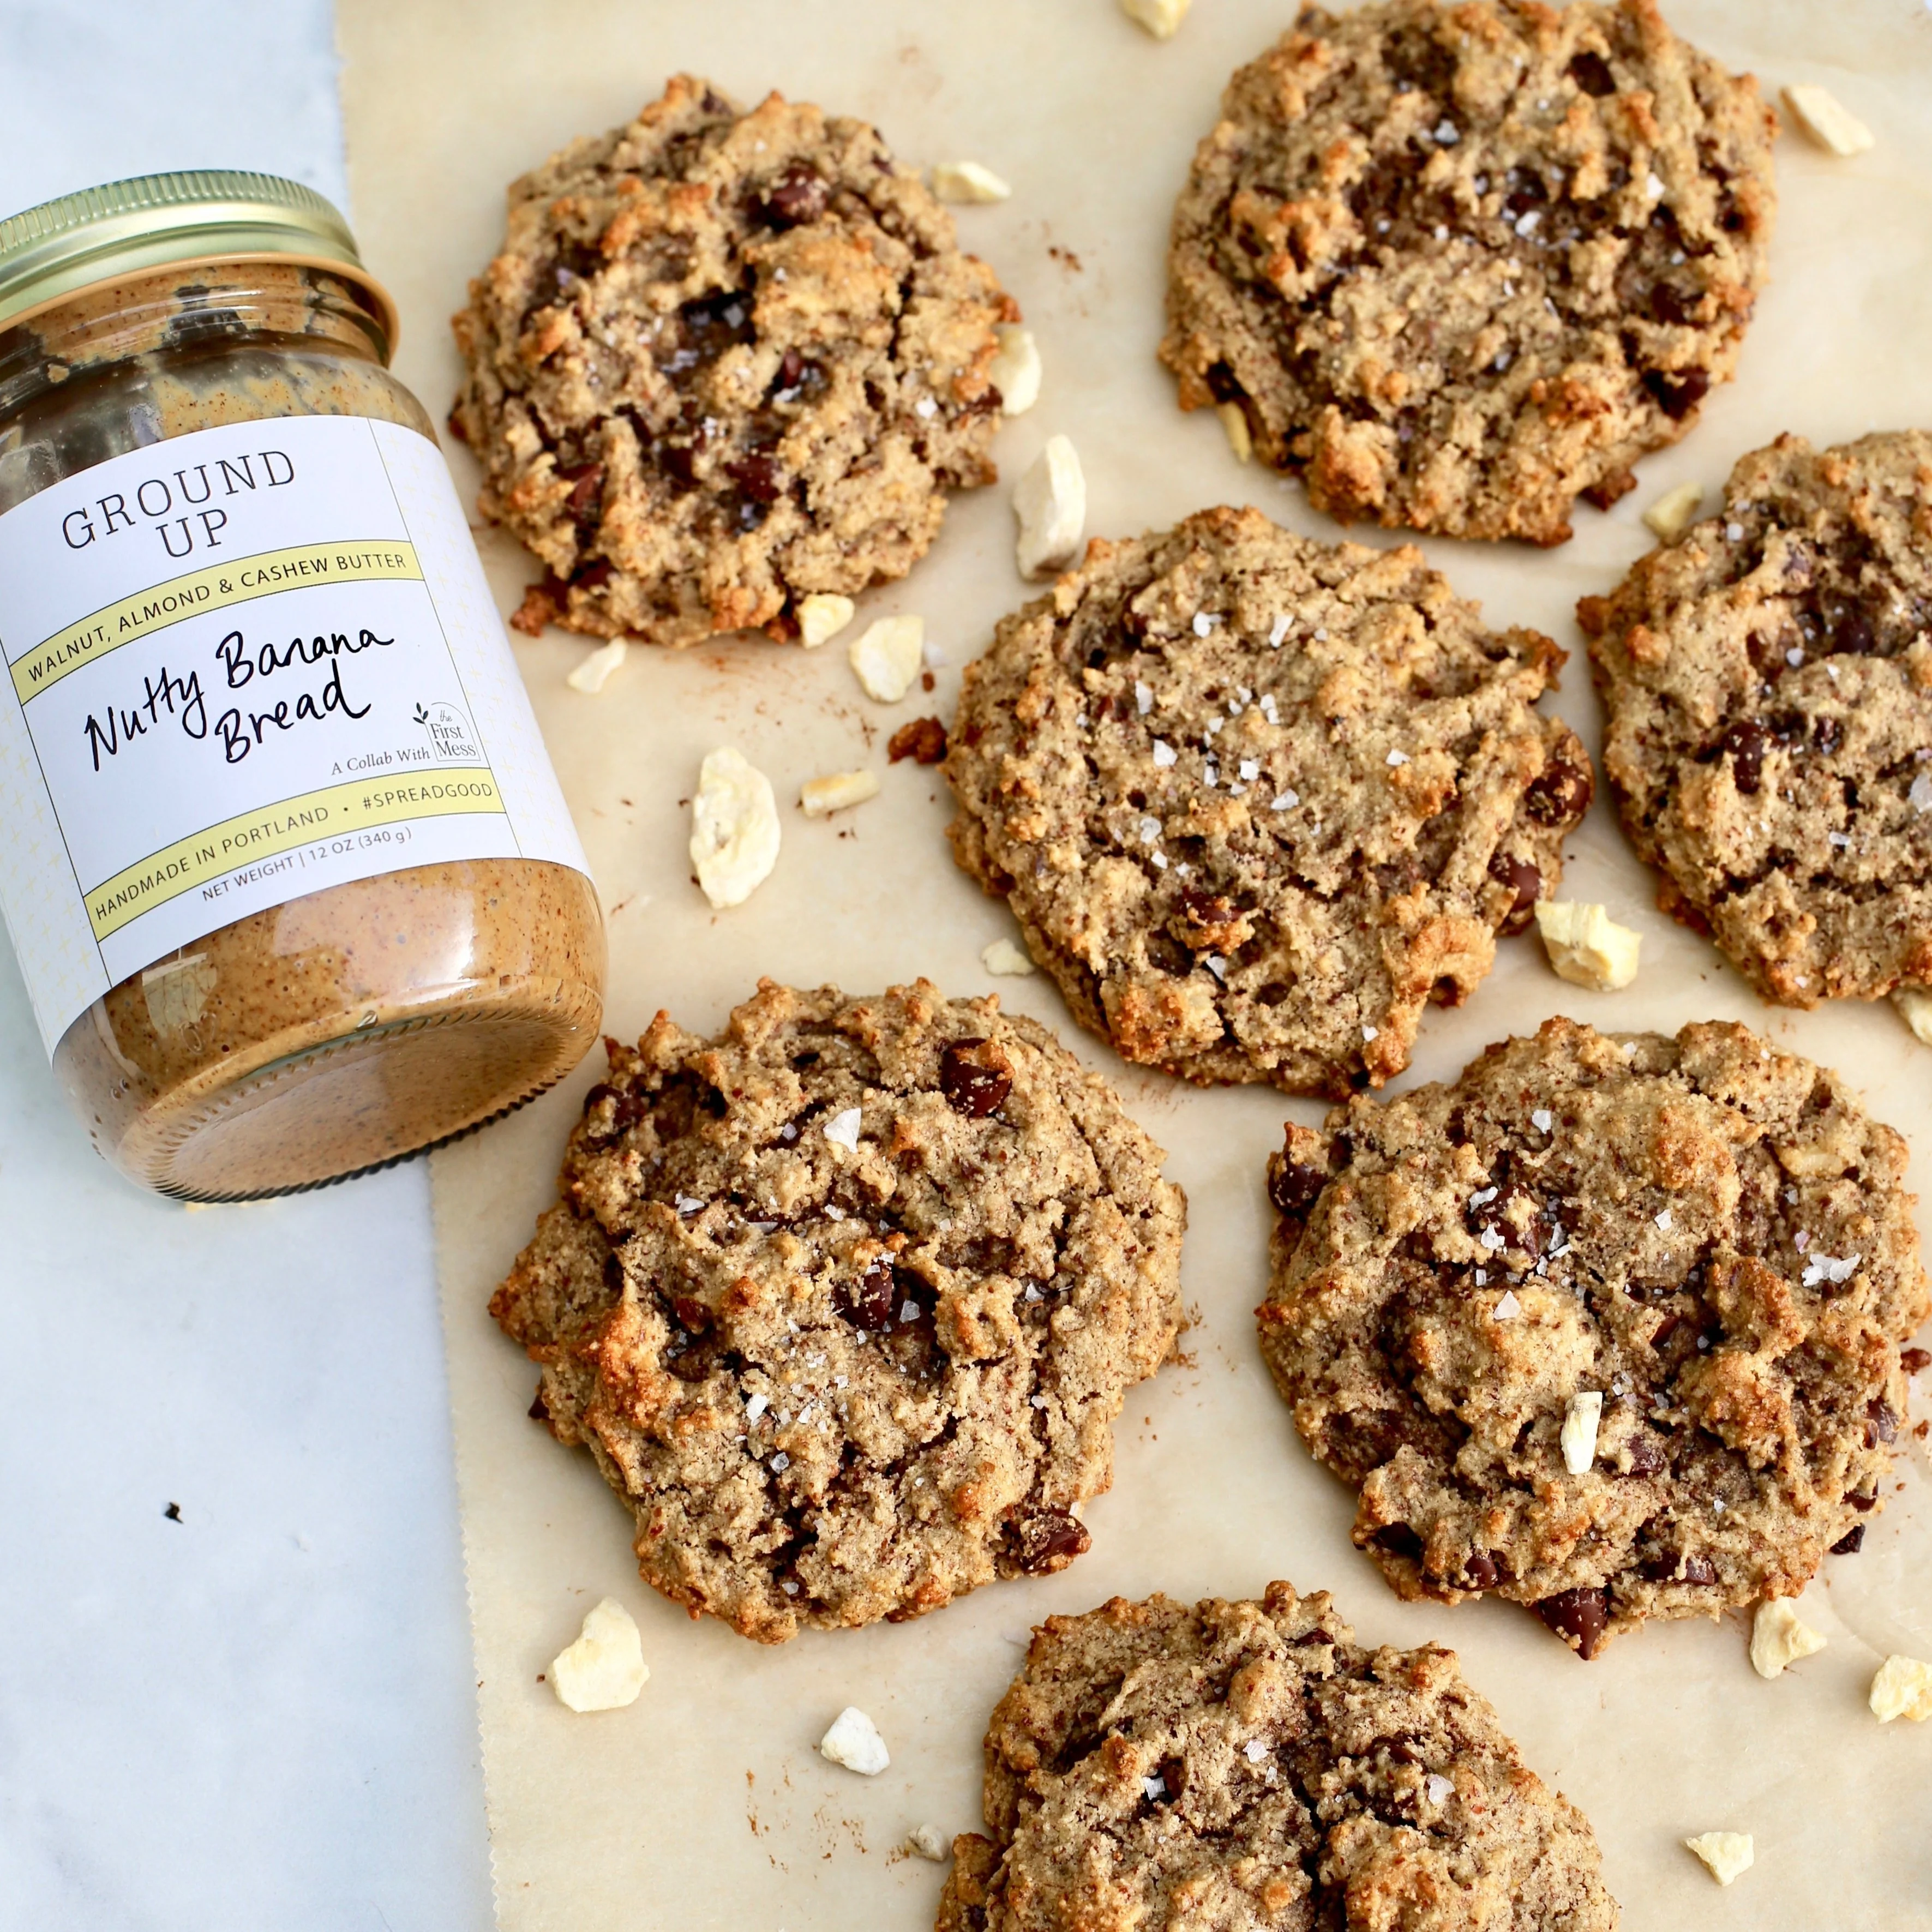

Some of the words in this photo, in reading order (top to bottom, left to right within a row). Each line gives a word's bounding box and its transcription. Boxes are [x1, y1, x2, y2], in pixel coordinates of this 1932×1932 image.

[63, 451, 295, 549] GROUND
[156, 509, 227, 557] UP
[28, 626, 111, 681] WALNUT,
[119, 585, 210, 632] ALMOND
[219, 579, 233, 593] &
[241, 558, 328, 587] CASHEW
[336, 554, 406, 570] BUTTER
[84, 667, 207, 771] Nutty
[215, 629, 394, 688] Banana
[214, 658, 371, 763] Bread
[430, 723, 465, 739] First
[440, 710, 453, 722] the
[331, 762, 343, 776] A
[347, 751, 392, 771] Collab
[396, 747, 430, 762] With
[435, 741, 476, 757] Mess
[95, 857, 190, 920] HANDMADE
[196, 845, 215, 865] IN
[222, 807, 328, 854] PORTLAND
[362, 783, 492, 809] #SPREADGOOD
[202, 880, 230, 901] NET
[234, 856, 293, 887] WEIGHT
[309, 847, 328, 861] 12
[332, 838, 355, 854] OZ
[358, 831, 391, 849] (340
[395, 826, 412, 843] g)
